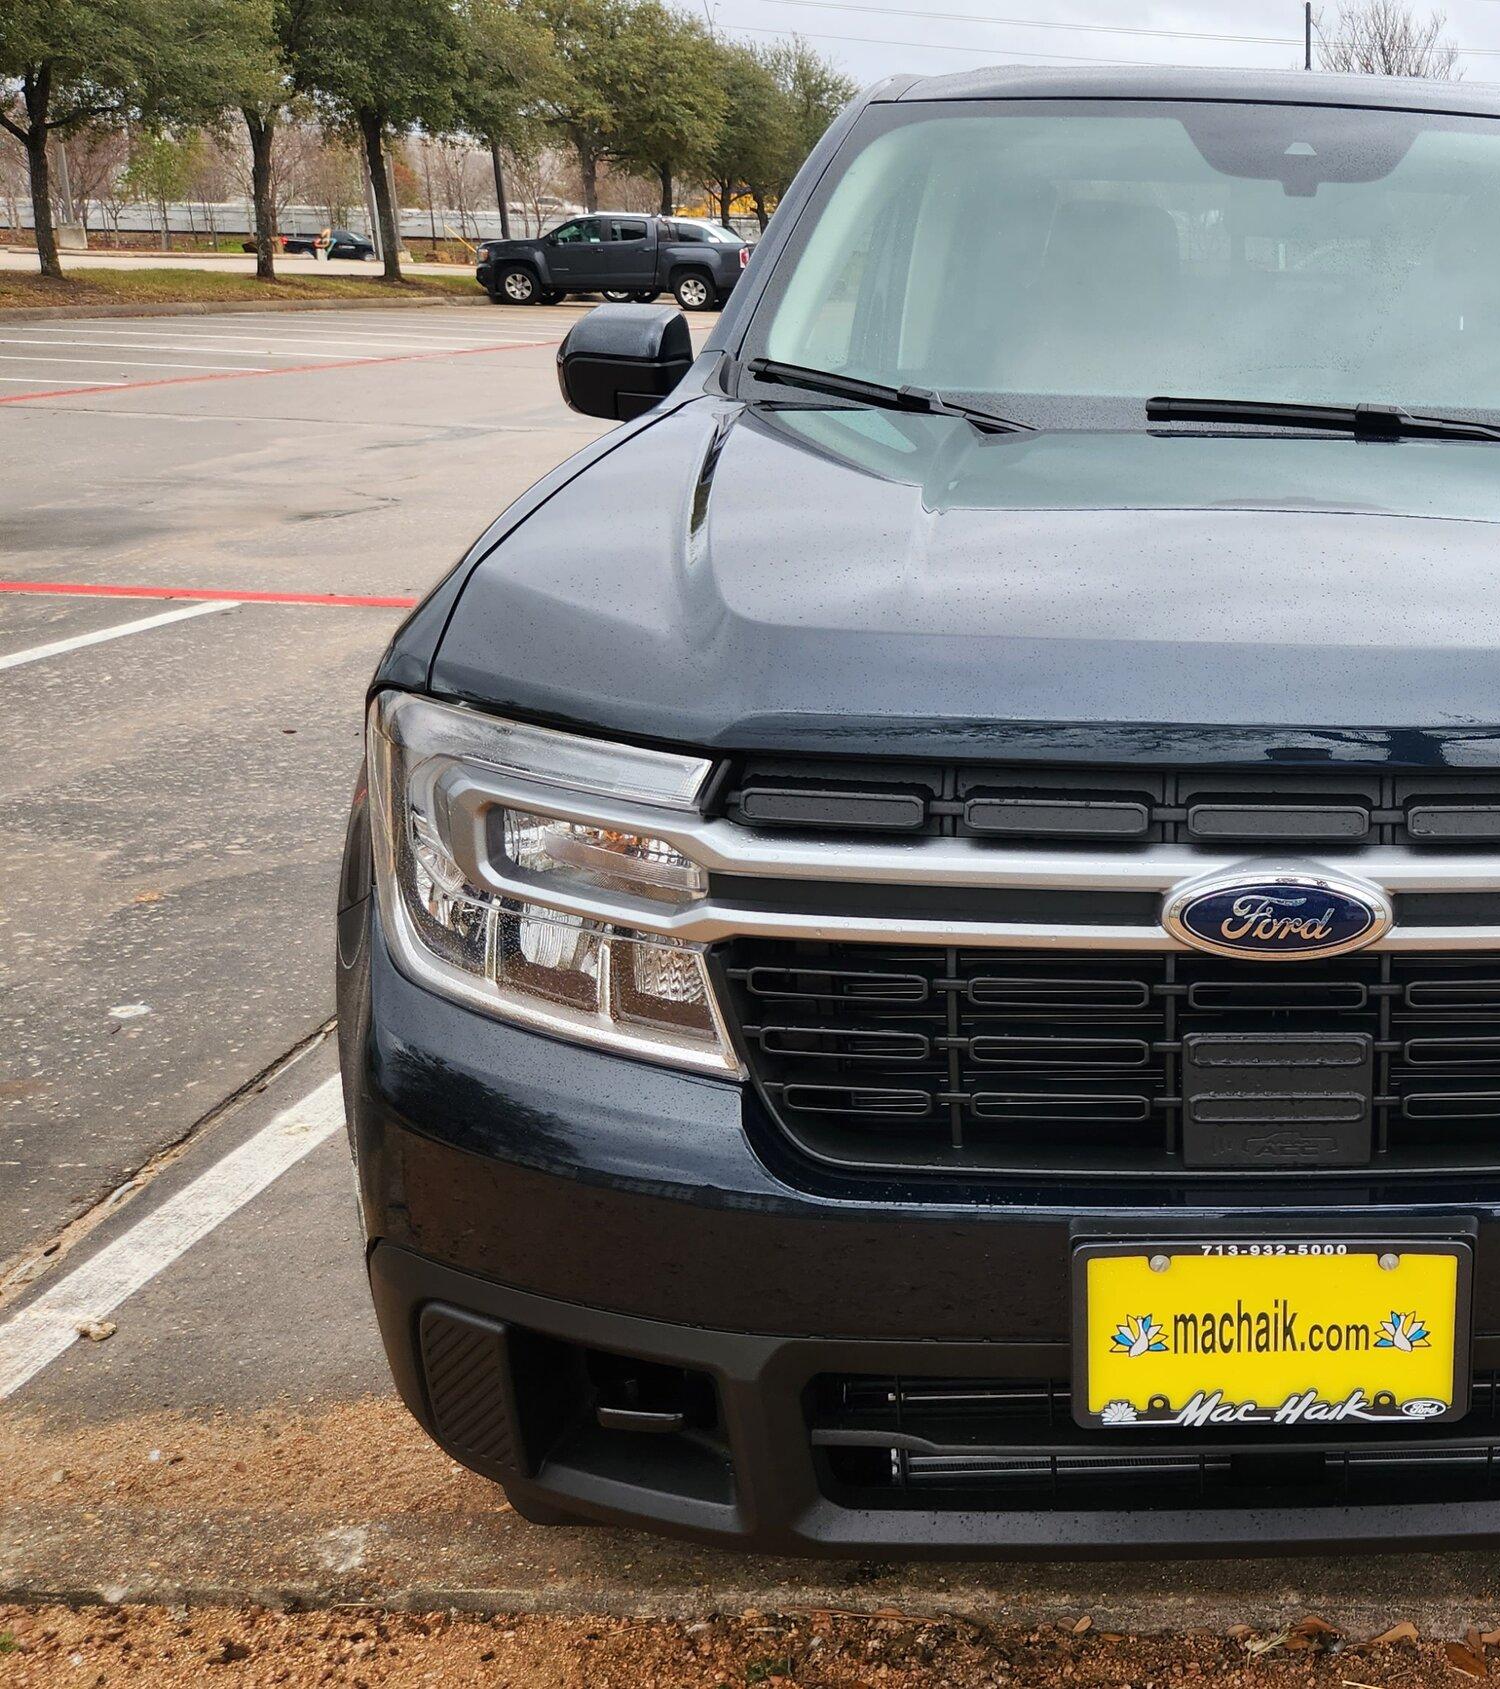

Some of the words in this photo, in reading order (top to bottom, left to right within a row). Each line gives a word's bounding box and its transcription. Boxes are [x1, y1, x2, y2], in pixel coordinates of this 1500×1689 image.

[1221, 894, 1336, 940] Ford
[1201, 1244, 1348, 1256] 713-932-5000
[1173, 1299, 1370, 1355] machaik.com
[1176, 1391, 1271, 1427] Mac
[1273, 1388, 1374, 1425] Haik
[1409, 1402, 1439, 1415] Ford
